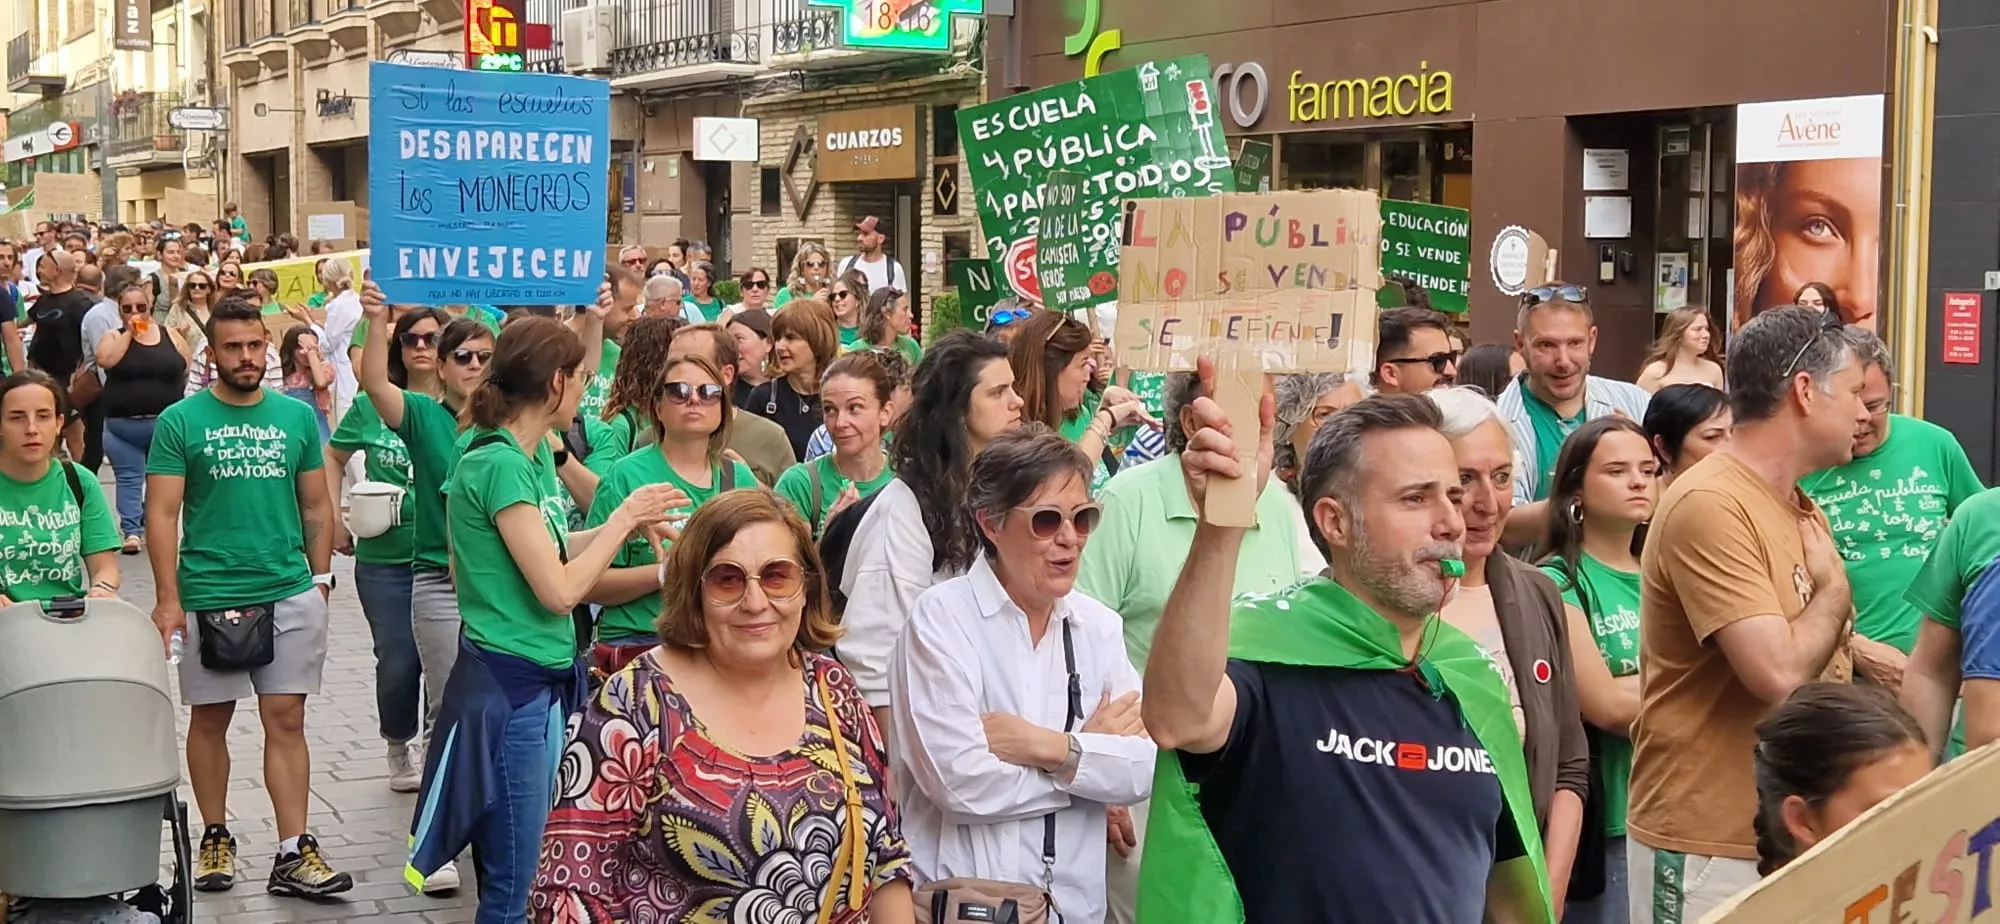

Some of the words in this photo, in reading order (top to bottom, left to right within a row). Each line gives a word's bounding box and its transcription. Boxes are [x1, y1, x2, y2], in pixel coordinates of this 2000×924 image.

[865, 1, 931, 32] 18:16
[401, 83, 429, 112] Si
[448, 79, 473, 115] las
[499, 85, 594, 116] escuelas
[1288, 60, 1453, 122] farmacia
[972, 93, 1097, 141] ESCUELA
[1777, 112, 1841, 142] Avène
[400, 129, 592, 164] DESAPARECEN
[826, 127, 903, 152] CUARZOS
[1013, 123, 1157, 175] PÚBLICA
[459, 171, 591, 214] MONEGROS
[1061, 184, 1076, 206] SOY
[1042, 216, 1052, 240] LA
[1055, 213, 1065, 239] DE
[1068, 212, 1079, 236] LA
[1389, 212, 1467, 238] EDUCACIÓN
[400, 246, 592, 279] ENVEJECEN
[1041, 243, 1080, 264] CAMISETA
[1395, 242, 1411, 257] SE
[1417, 246, 1461, 265] VENDE
[1041, 267, 1066, 289] VERDE
[1132, 260, 1187, 304] NO
[1216, 269, 1247, 295] SE
[1131, 318, 1182, 350] SE
[0, 509, 33, 528] UELA
[36, 508, 80, 530] PÚBLIC
[0, 546, 16, 560] E
[1316, 728, 1396, 767] JACK
[1427, 745, 1496, 774] JONE
